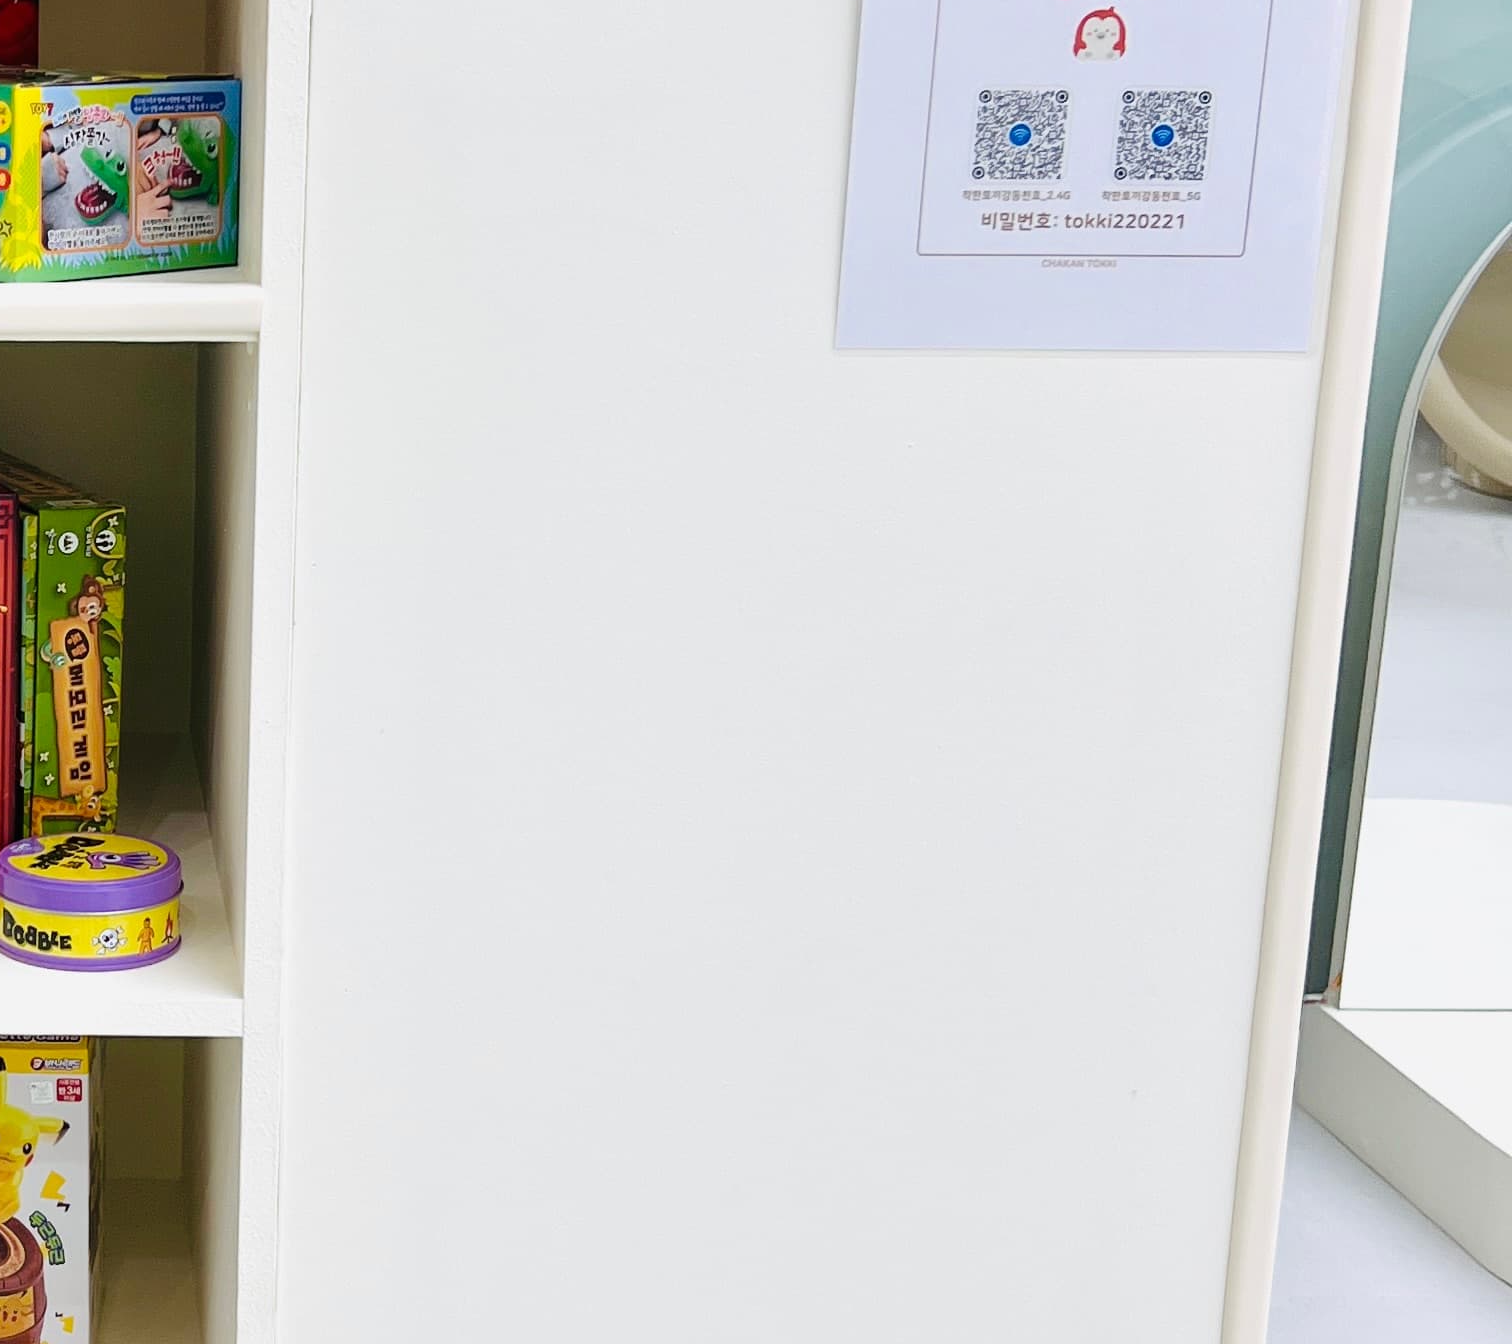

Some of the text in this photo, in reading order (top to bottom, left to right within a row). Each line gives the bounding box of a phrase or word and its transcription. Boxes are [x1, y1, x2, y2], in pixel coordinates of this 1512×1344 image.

[980, 212, 1186, 231] 비밀번호: tokki220221
[66, 662, 92, 782] 메모리 게임
[2, 906, 72, 951] DOBBLE
